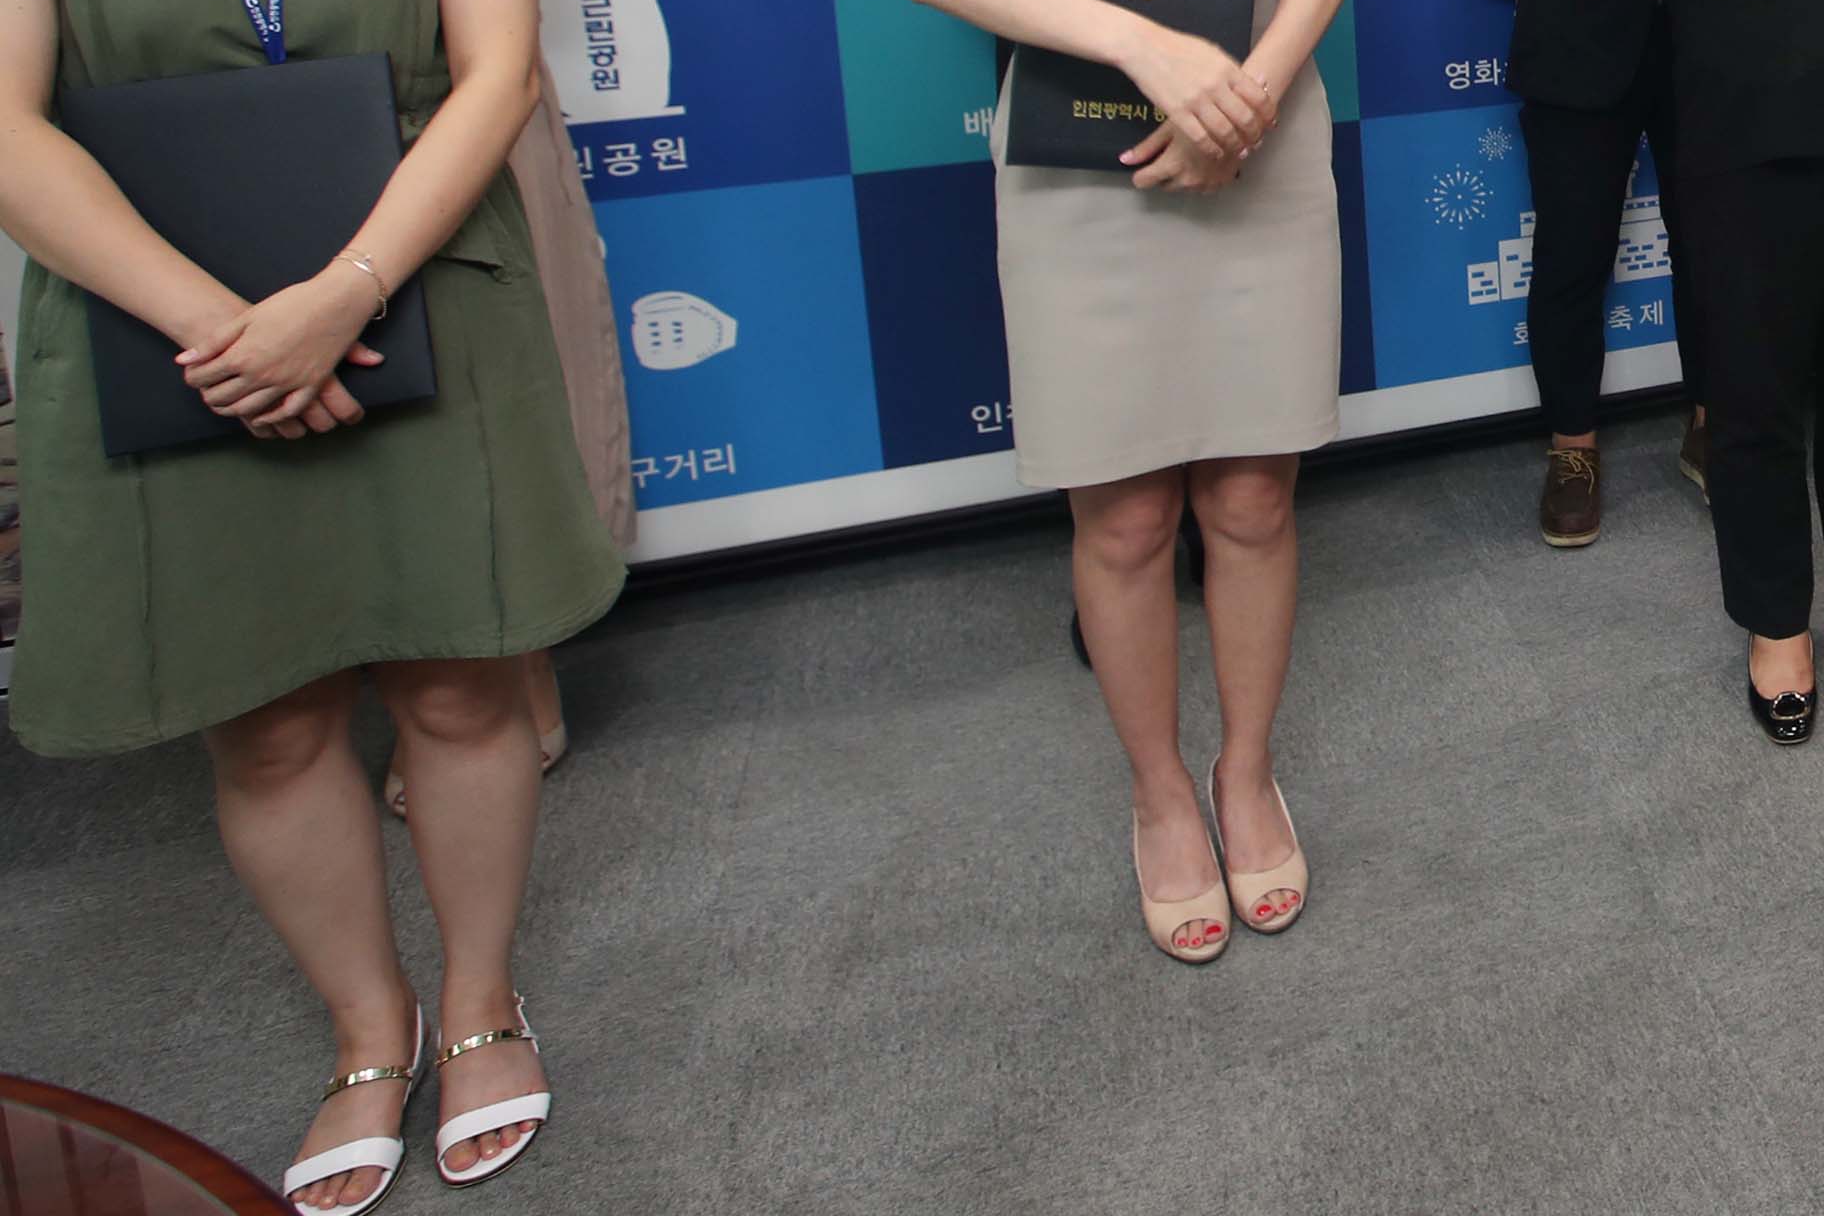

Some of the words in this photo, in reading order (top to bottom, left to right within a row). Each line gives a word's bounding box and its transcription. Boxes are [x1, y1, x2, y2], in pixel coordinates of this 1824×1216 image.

[1445, 58, 1508, 90] 영화
[1073, 99, 1148, 121] 인천광역시
[630, 443, 736, 488] 구거리
